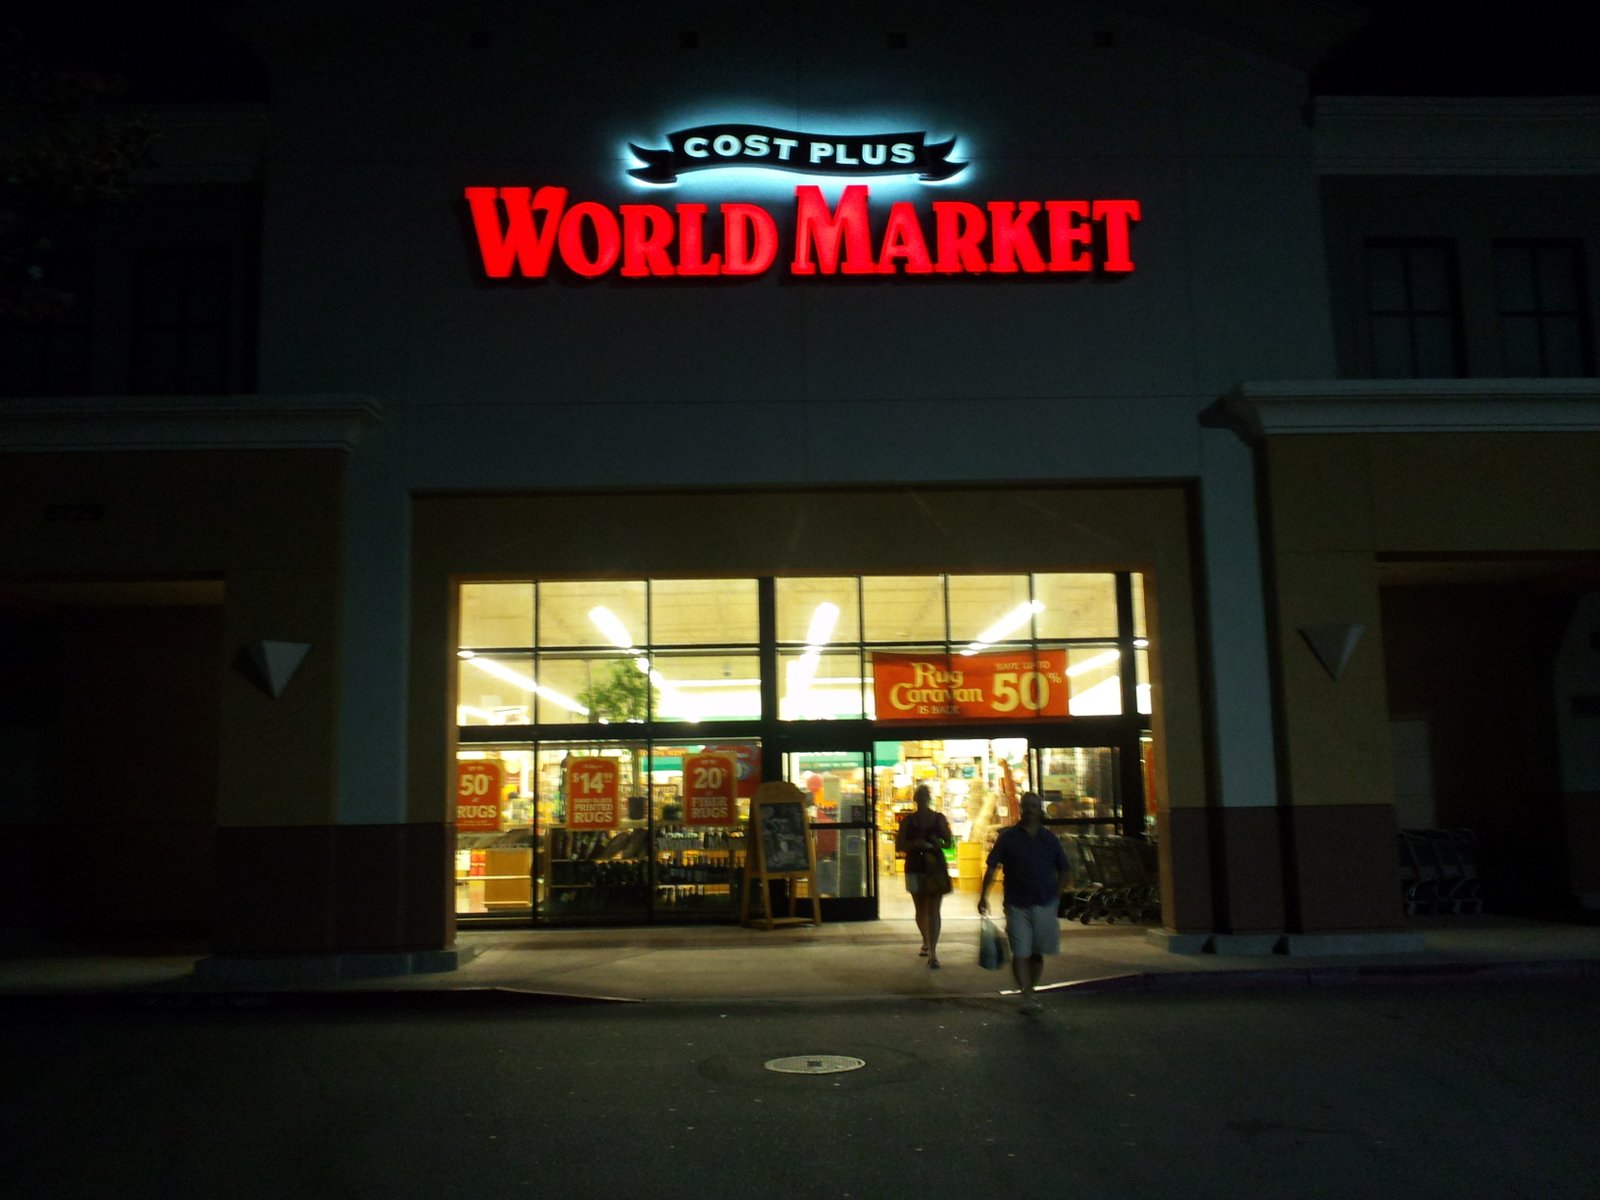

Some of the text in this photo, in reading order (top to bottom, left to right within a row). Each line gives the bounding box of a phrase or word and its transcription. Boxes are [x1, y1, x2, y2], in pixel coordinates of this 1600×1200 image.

[684, 134, 916, 165] COST PLUS
[465, 185, 1141, 277] WORLD MARKET
[912, 662, 964, 688] Rug
[889, 683, 984, 710] Caravan
[991, 672, 1062, 712] 50%
[457, 805, 498, 818] RUGS
[574, 811, 614, 823] RUGS
[575, 803, 614, 811] PRINTED
[691, 807, 729, 818] RUGS
